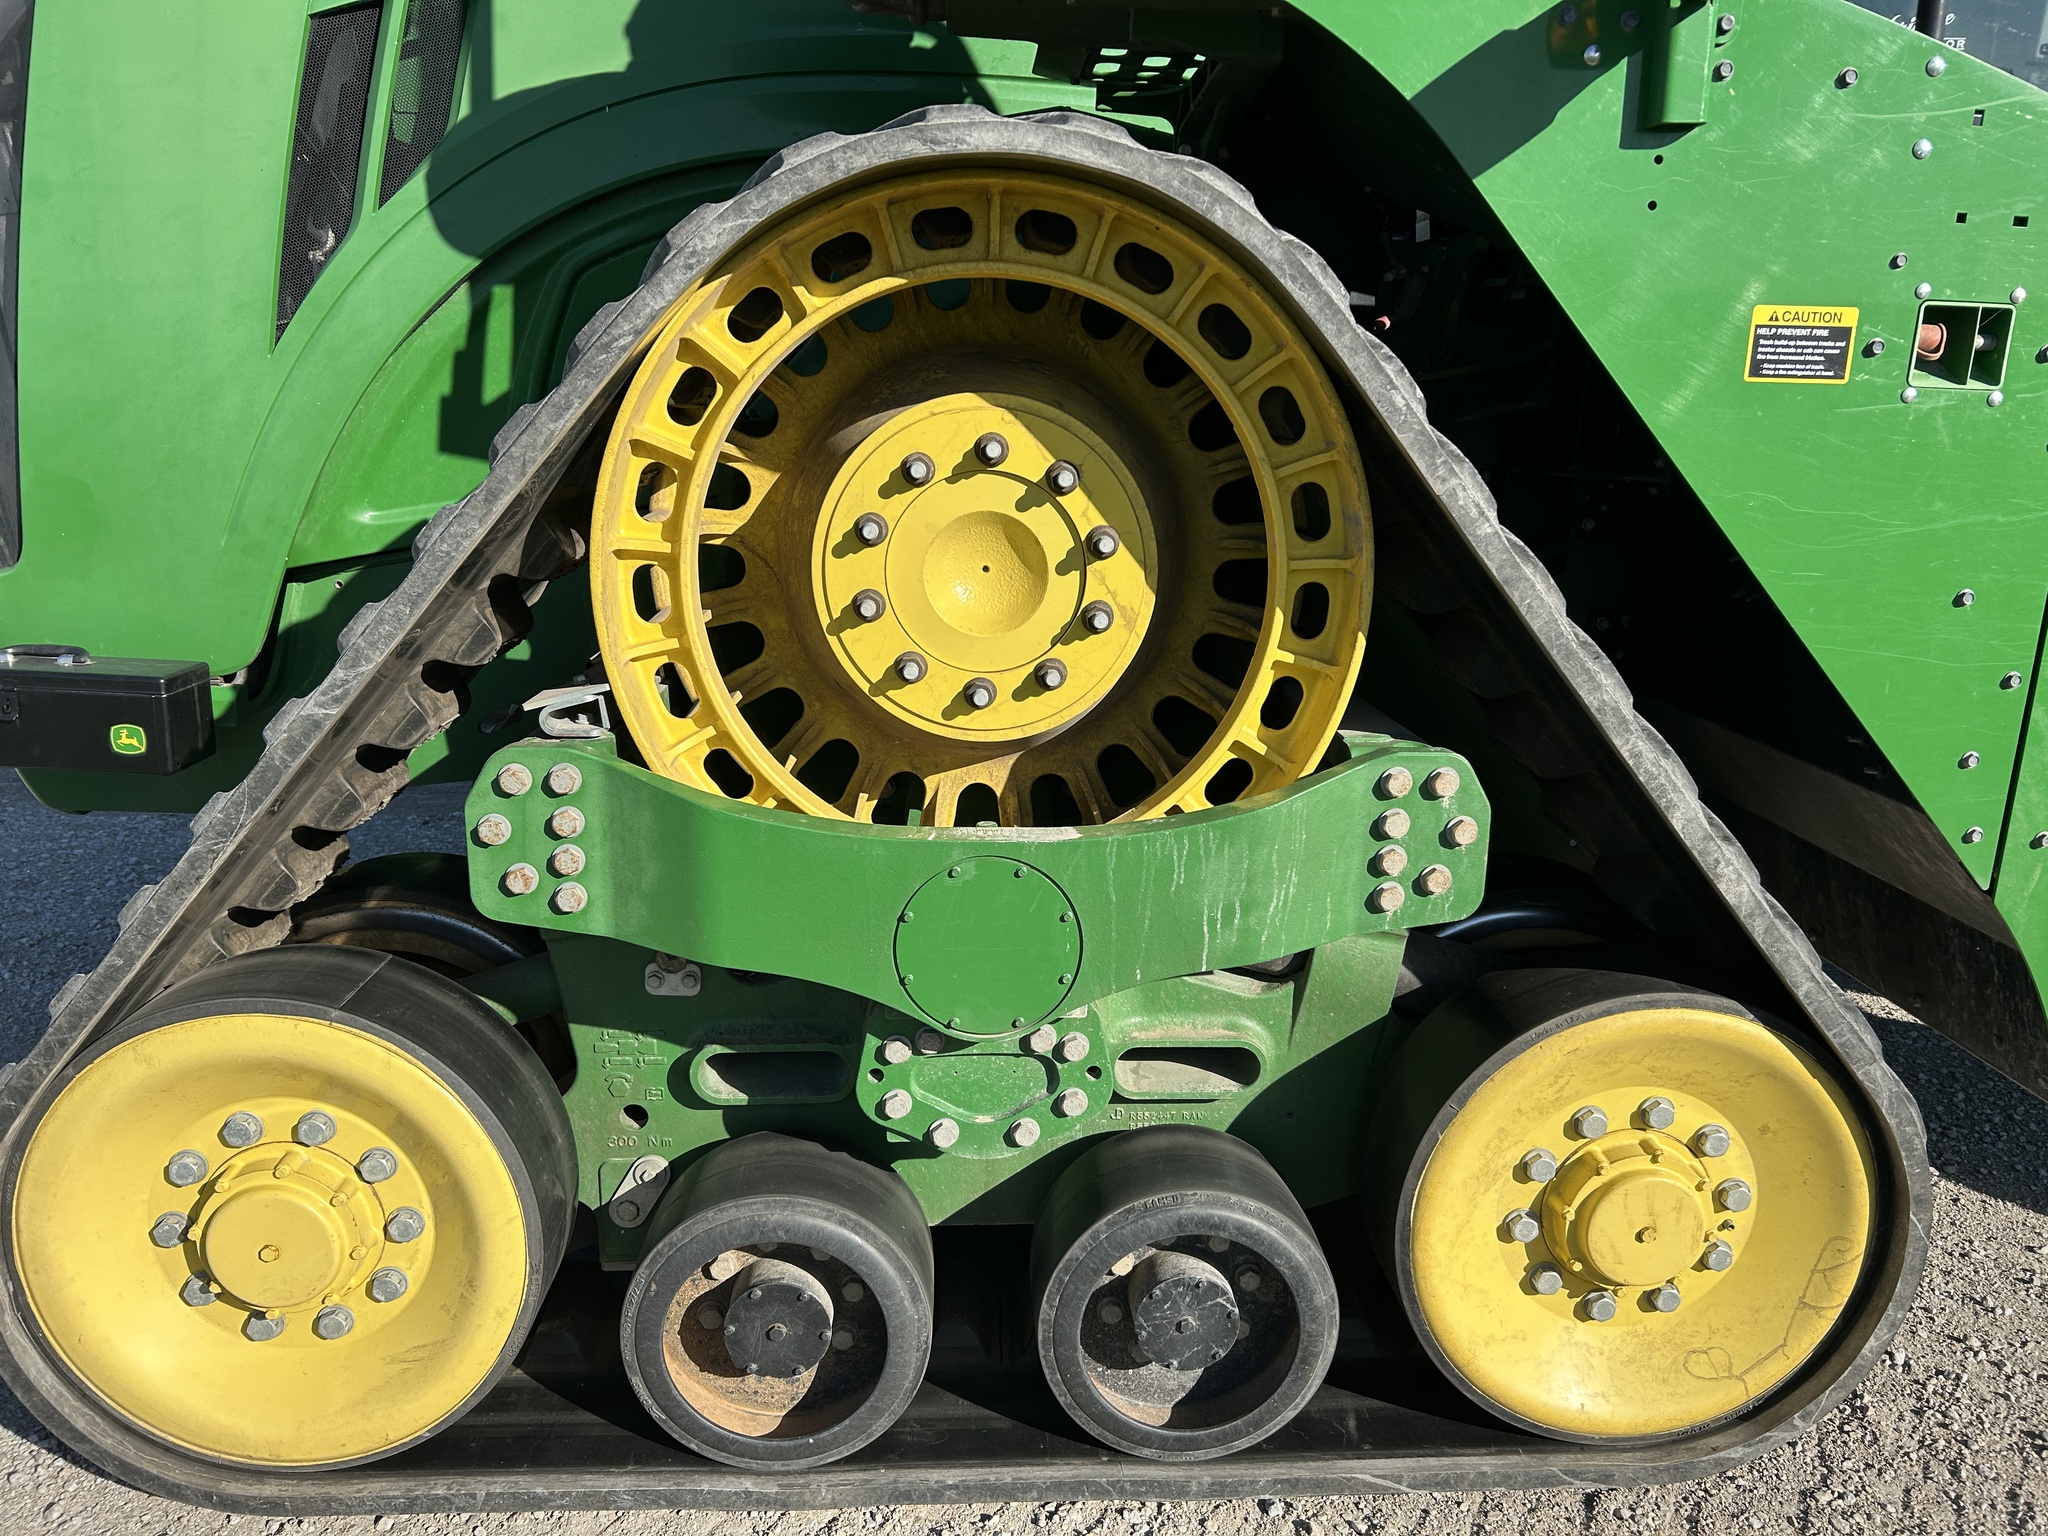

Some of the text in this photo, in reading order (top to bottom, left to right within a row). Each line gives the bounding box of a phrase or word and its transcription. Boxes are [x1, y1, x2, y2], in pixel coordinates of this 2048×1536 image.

[1782, 311, 1843, 323] CAUTION
[1777, 328, 1812, 336] PREVENT
[607, 1135, 638, 1148] 300
